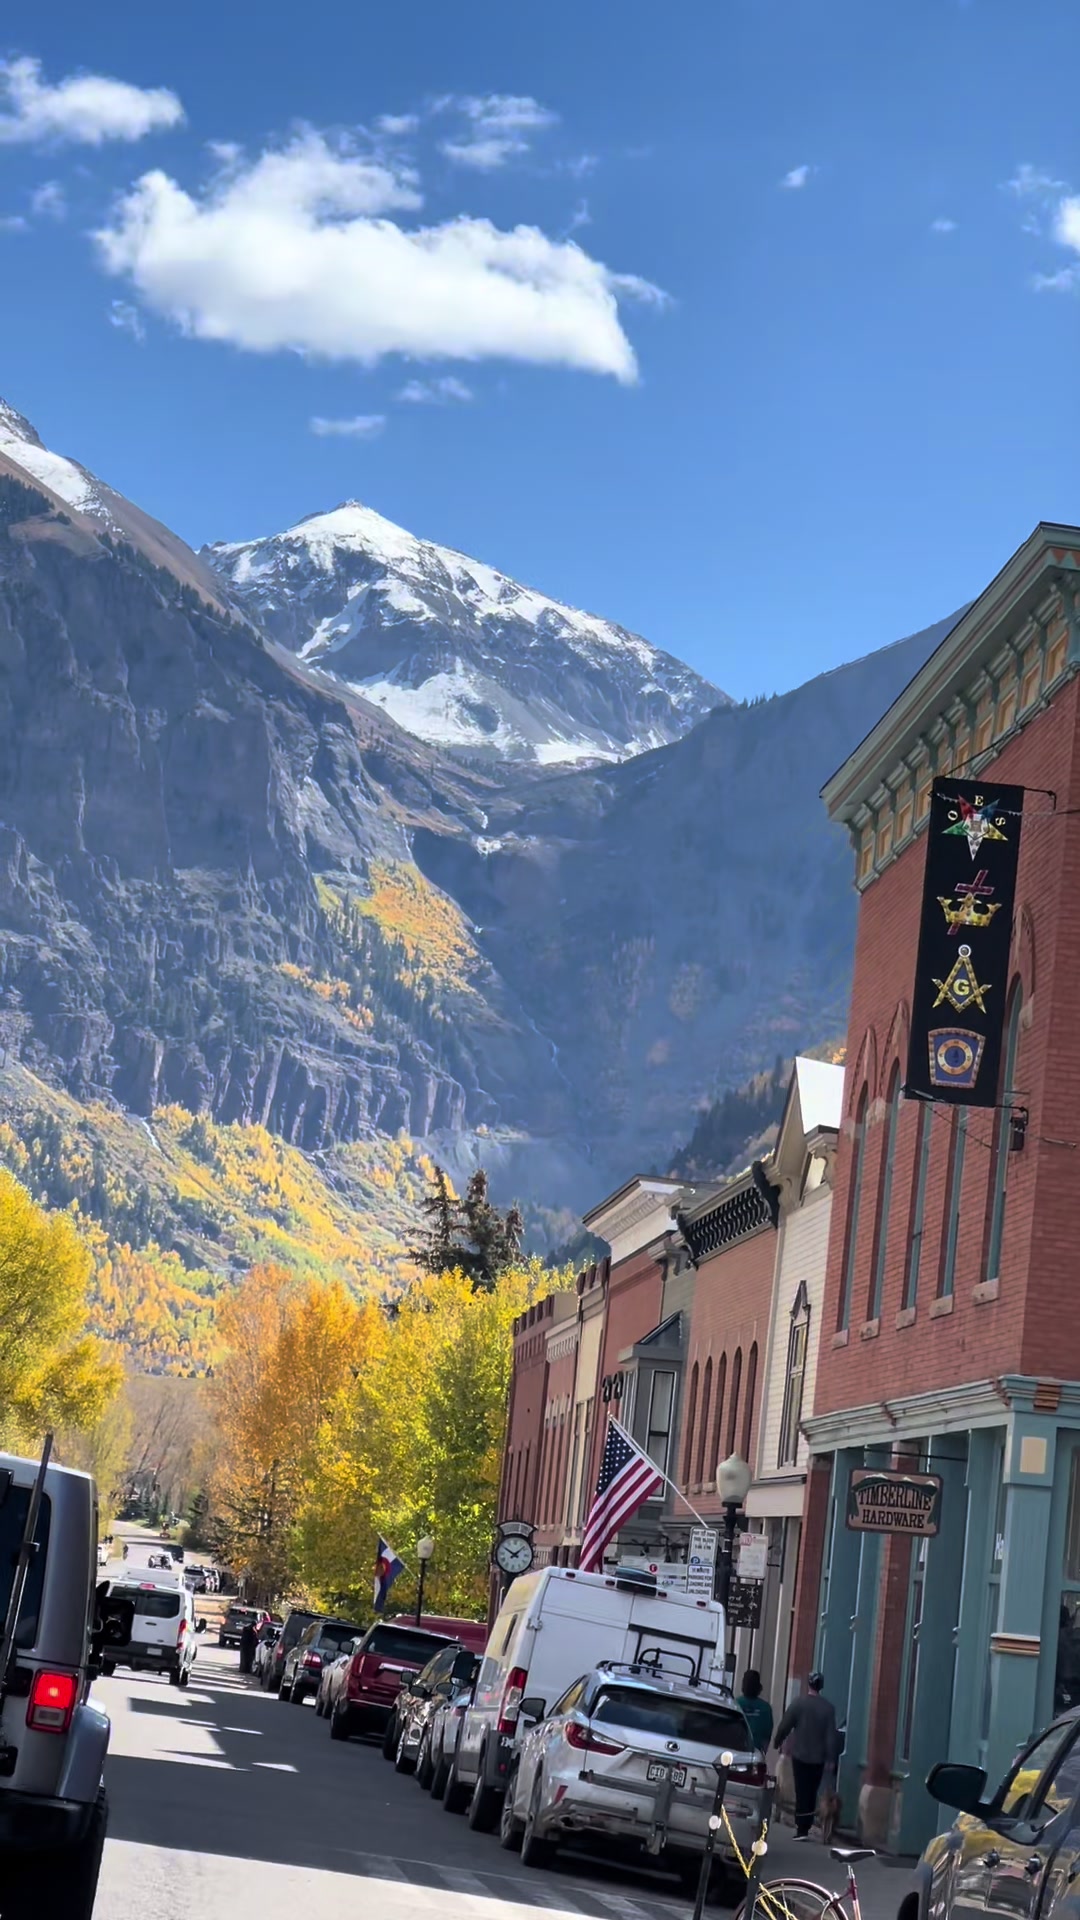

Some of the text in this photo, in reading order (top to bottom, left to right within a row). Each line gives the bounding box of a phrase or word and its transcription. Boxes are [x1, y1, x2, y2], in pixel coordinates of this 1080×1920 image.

[974, 795, 984, 806] E
[995, 817, 1006, 827] S
[953, 979, 970, 996] G
[859, 1484, 931, 1511] TIMBERLINE
[862, 1509, 925, 1528] HARDWARE
